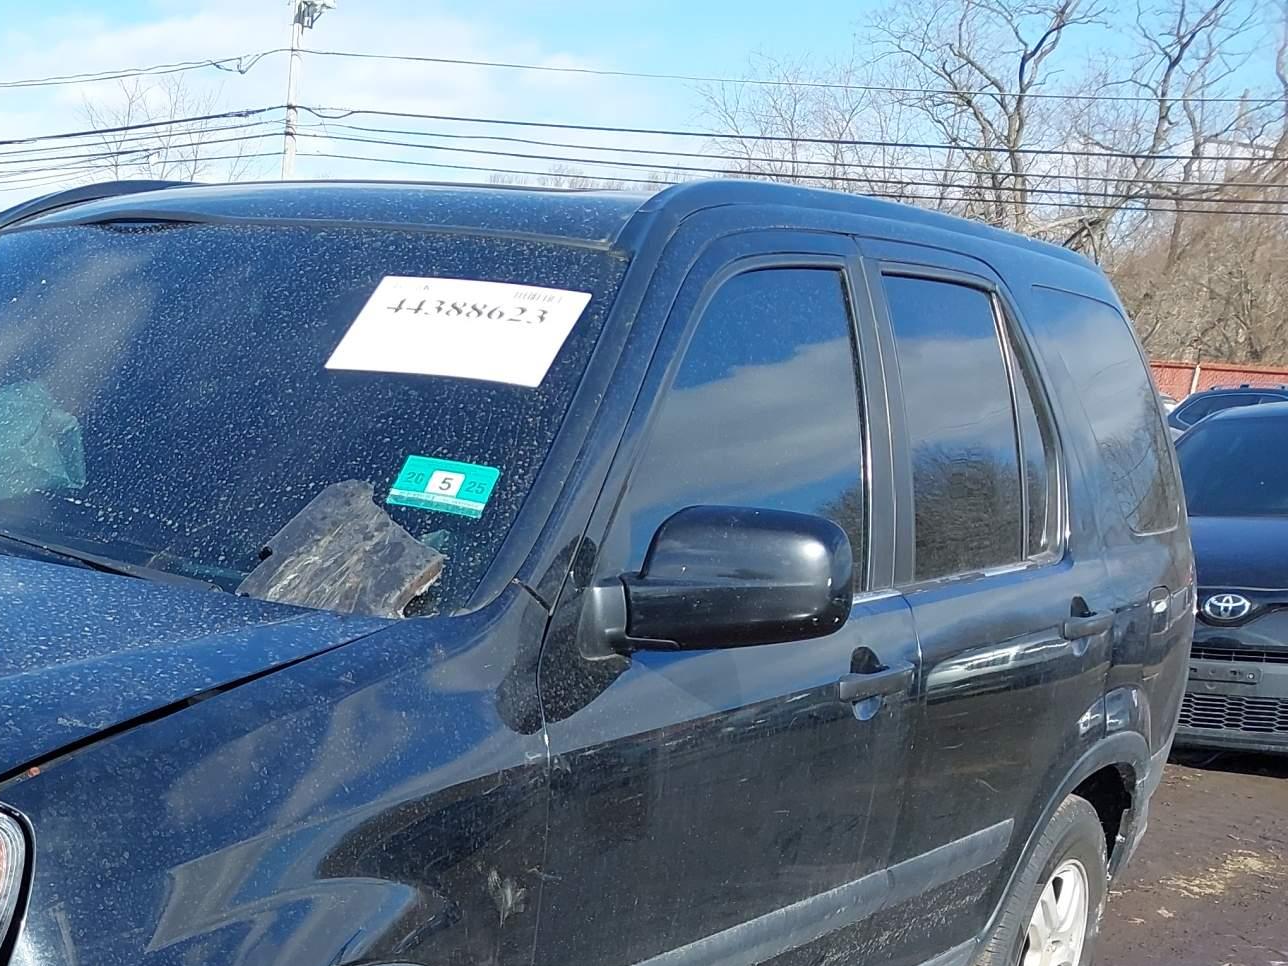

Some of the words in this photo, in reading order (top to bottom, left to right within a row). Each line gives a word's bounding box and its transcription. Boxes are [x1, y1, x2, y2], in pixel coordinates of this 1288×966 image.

[386, 298, 548, 324] 44388623
[438, 477, 453, 491] 5
[465, 480, 487, 495] 25
